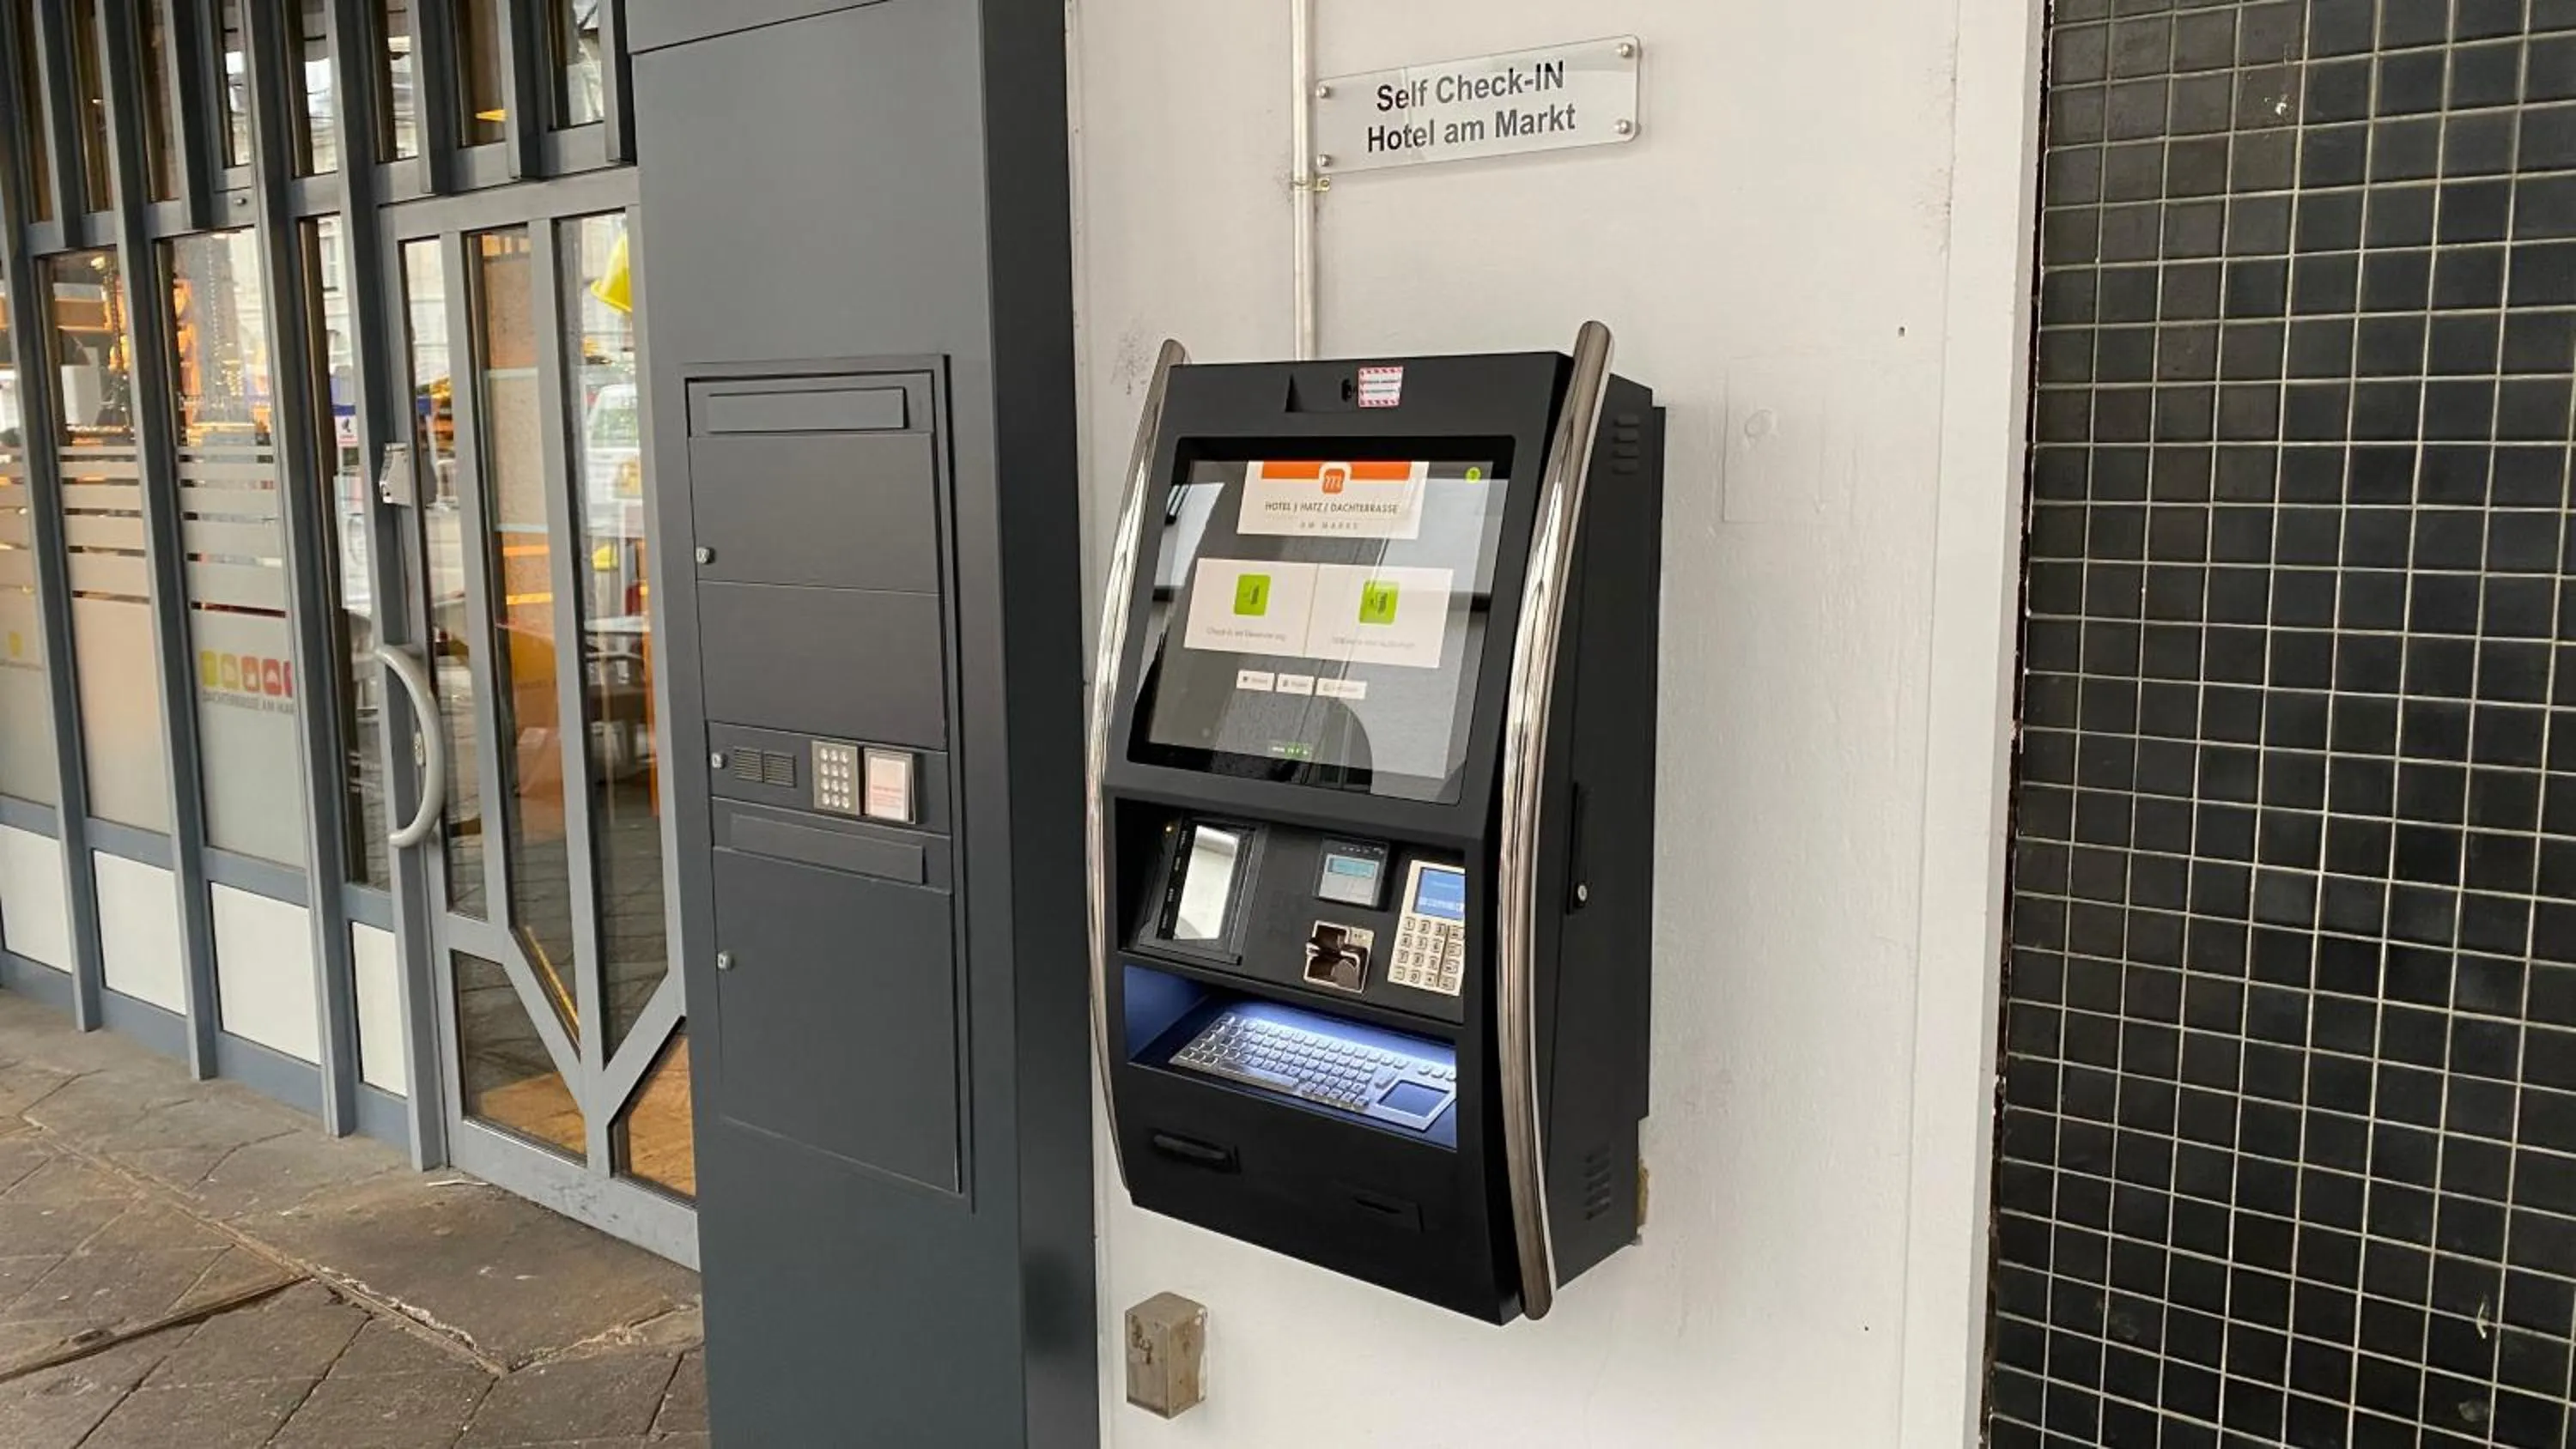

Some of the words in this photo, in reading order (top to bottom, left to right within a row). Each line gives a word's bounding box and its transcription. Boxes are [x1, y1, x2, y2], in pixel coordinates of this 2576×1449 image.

[1376, 79, 1429, 112] Self
[1436, 60, 1564, 104] Check-IN
[1368, 118, 1435, 153] Hotel
[1443, 119, 1485, 144] am
[1495, 103, 1577, 138] Markt
[1265, 500, 1291, 512] HOTEL
